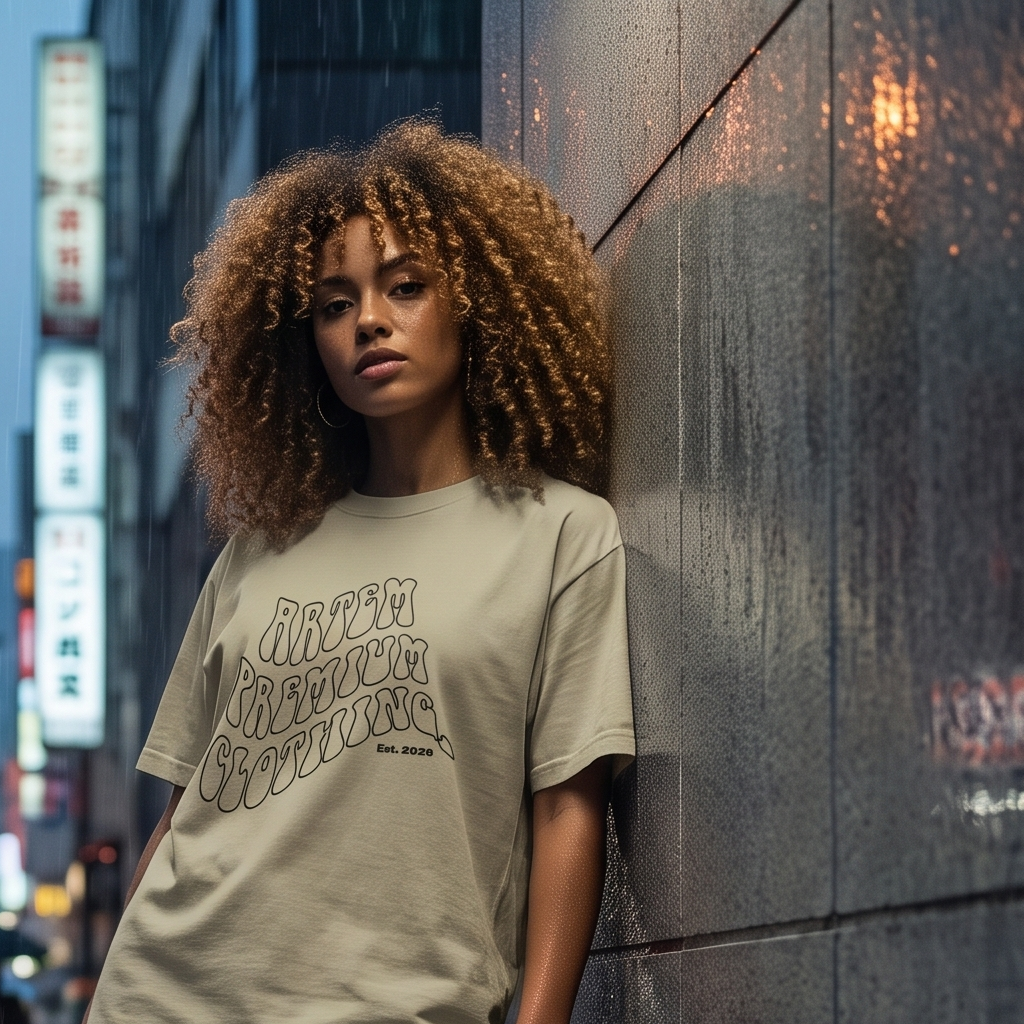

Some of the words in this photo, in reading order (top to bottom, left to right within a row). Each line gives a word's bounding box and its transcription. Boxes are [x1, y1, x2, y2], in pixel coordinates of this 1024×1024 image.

[259, 577, 418, 667] ARTEM
[226, 633, 429, 740] PREMIUM
[199, 686, 456, 813] CLOTHING
[376, 743, 399, 754] Est.
[401, 745, 434, 757] 2026
